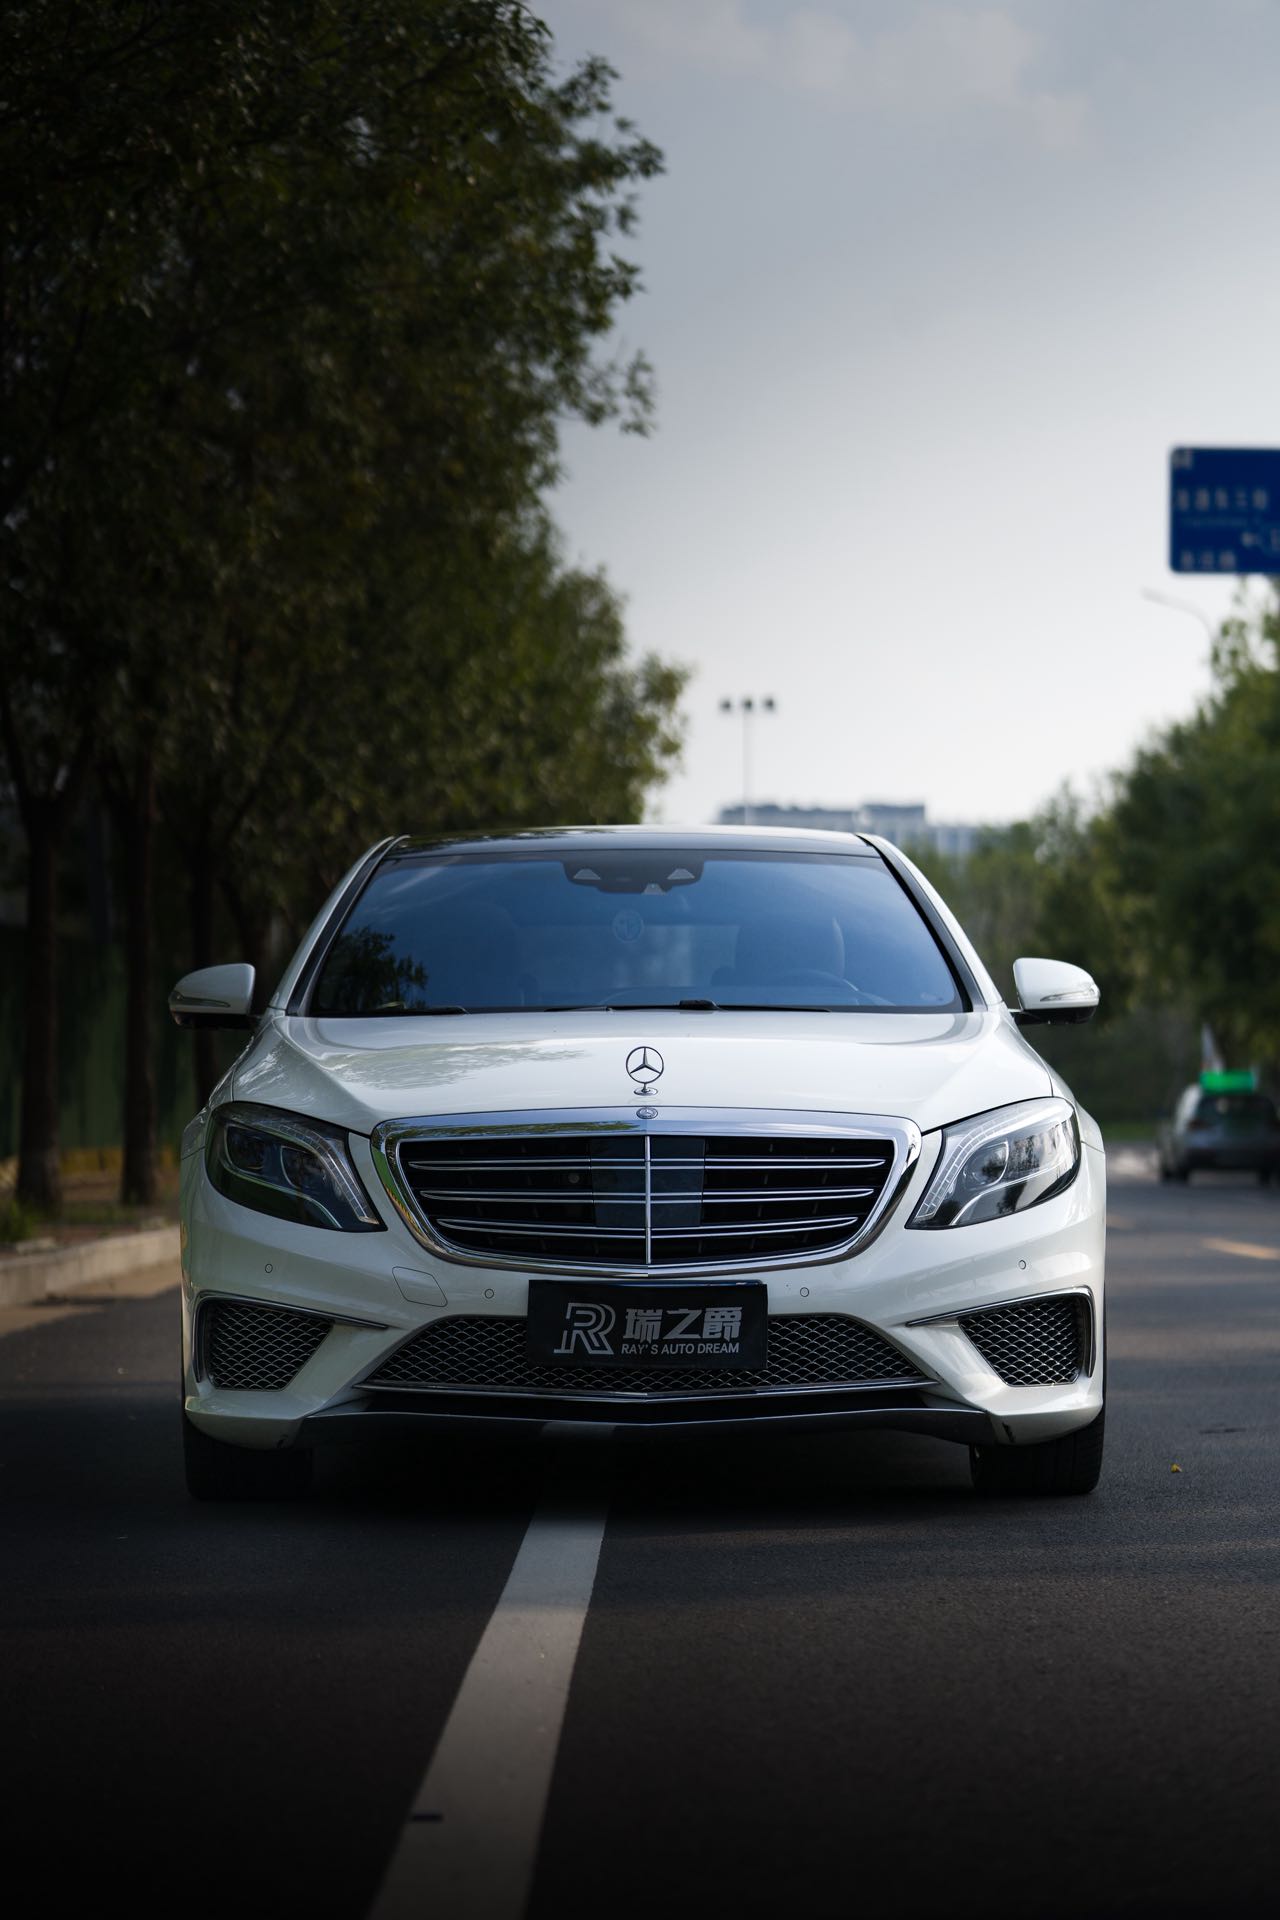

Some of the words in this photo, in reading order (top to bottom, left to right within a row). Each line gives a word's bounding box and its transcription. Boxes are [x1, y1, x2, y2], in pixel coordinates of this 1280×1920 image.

[622, 1306, 743, 1344] 瑞之爵
[661, 1343, 695, 1355] AUTO
[697, 1342, 740, 1354] DREAM
